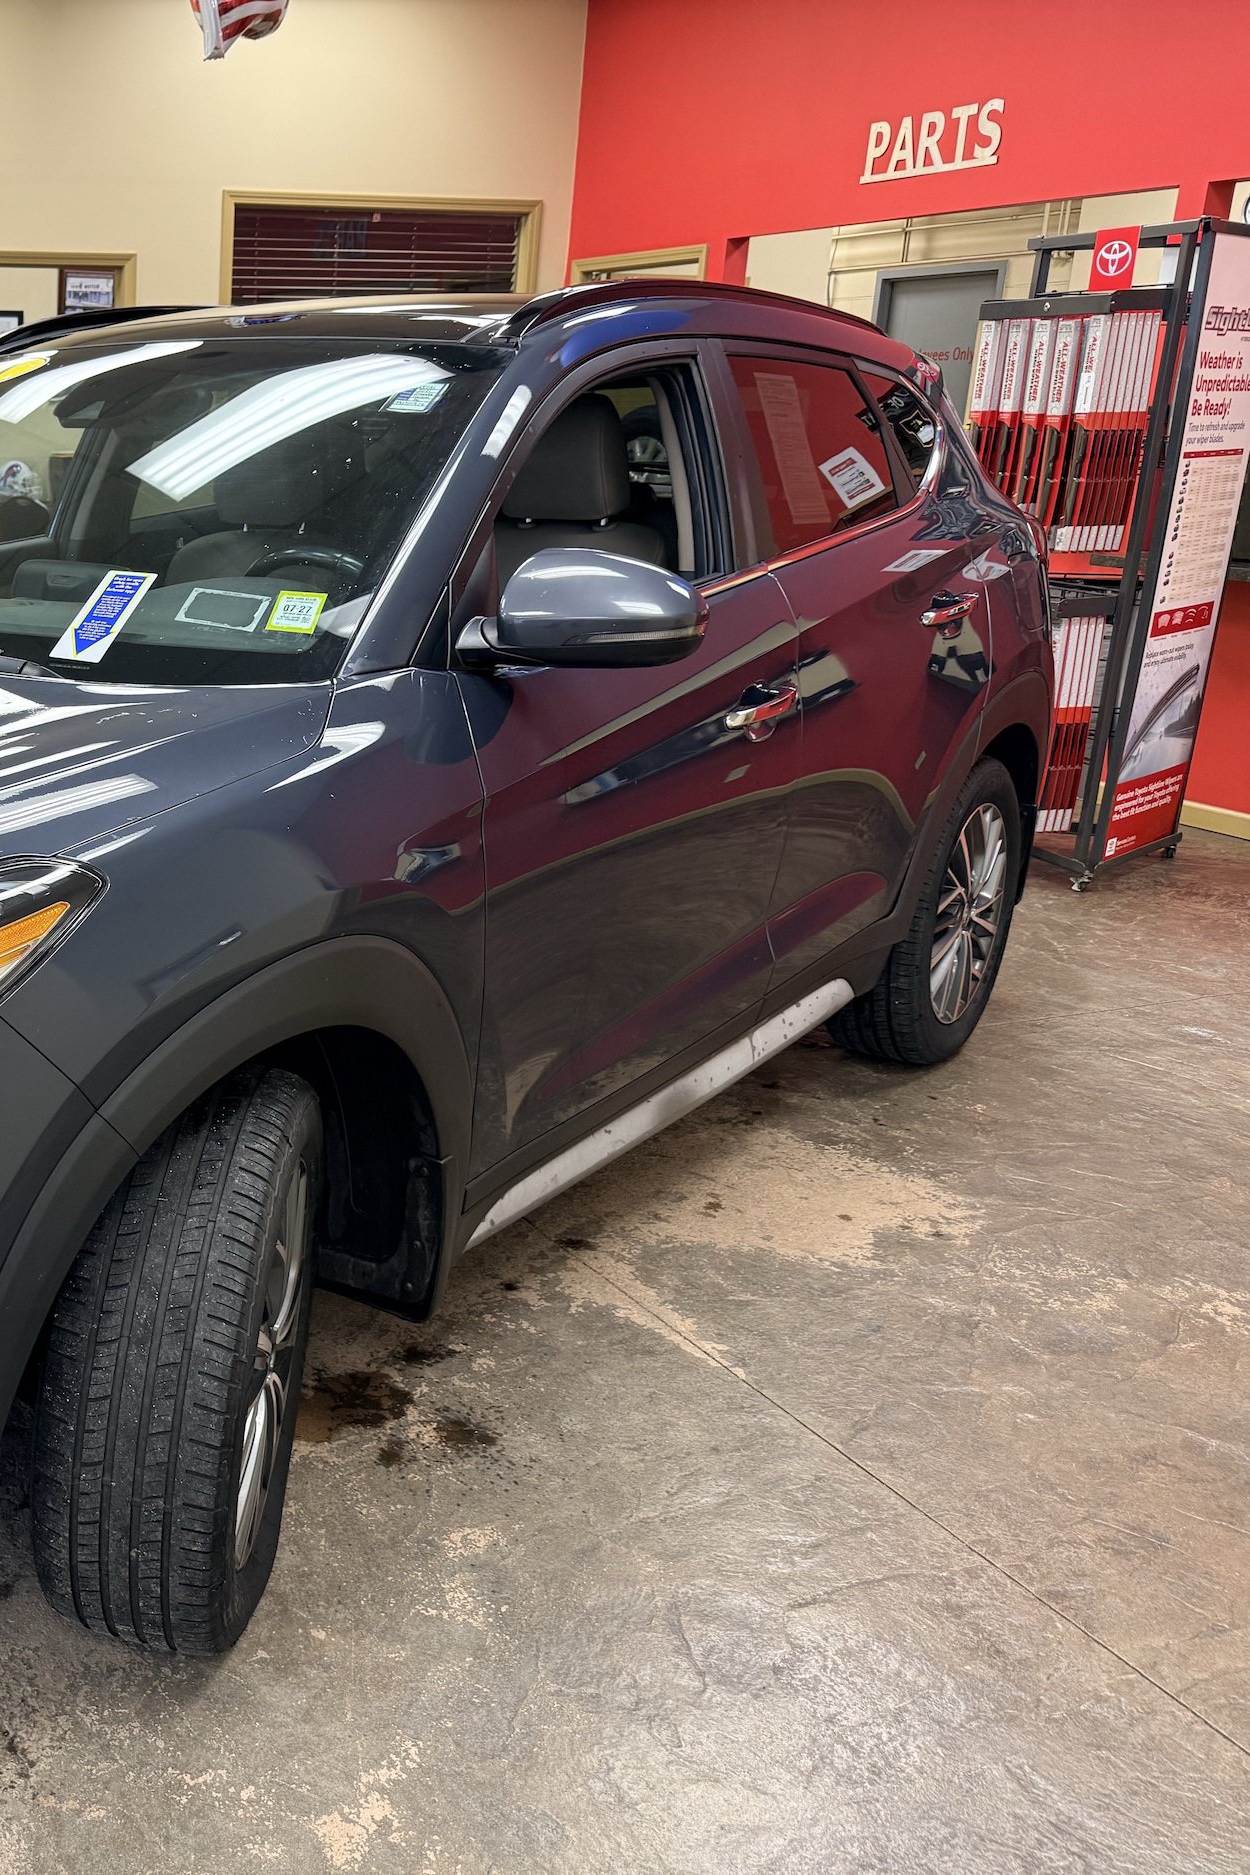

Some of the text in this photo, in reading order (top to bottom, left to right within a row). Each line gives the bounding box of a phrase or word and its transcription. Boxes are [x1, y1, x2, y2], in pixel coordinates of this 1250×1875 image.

[863, 98, 1005, 178] PARTS
[1200, 350, 1243, 369] Weather is
[978, 341, 989, 399] ALL-WEATHER
[1006, 341, 1017, 399] ALL-WEATHER
[1032, 341, 1044, 401] ALL-WEATHER
[1056, 342, 1068, 402] ALL-WEATHER
[1191, 398, 1232, 420] Be Ready!
[1189, 420, 1245, 432] Time to refresh and upgrade
[1185, 437, 1196, 446] your
[1197, 435, 1209, 445] wiper
[1116, 790, 1135, 801] Genuine
[1135, 786, 1148, 796] Toyota
[1114, 797, 1138, 812] engineered
[1120, 810, 1130, 819] best
